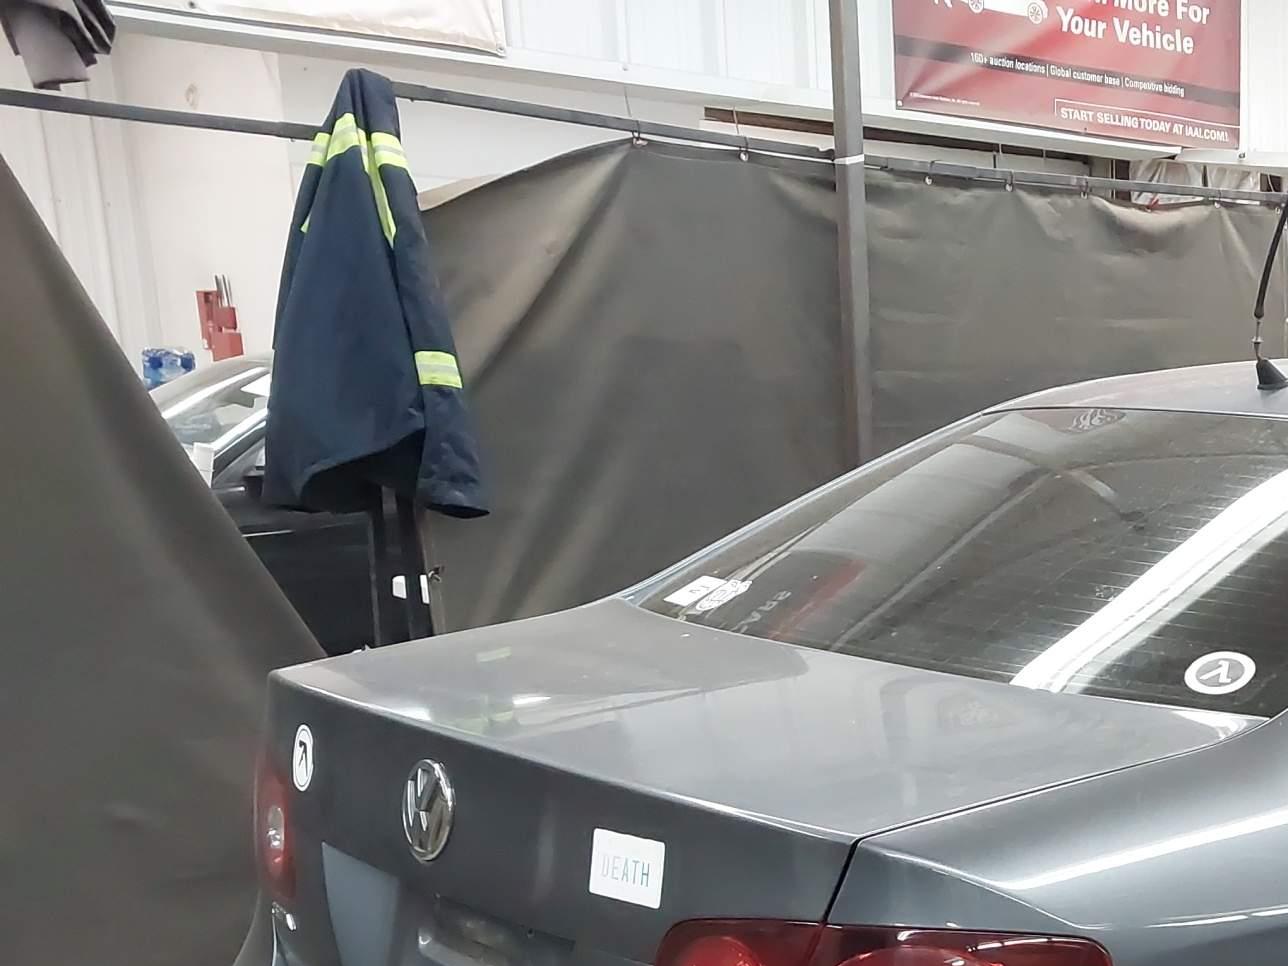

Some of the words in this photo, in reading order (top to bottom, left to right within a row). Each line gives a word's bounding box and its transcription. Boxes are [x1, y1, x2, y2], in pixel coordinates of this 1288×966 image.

[1176, 0, 1210, 24] For
[1056, 6, 1107, 39] Your
[1112, 16, 1195, 54] Vehicle
[990, 56, 1014, 69] auction
[1015, 59, 1045, 74] locations
[1050, 65, 1072, 78] Global
[1072, 70, 1103, 83] customer
[1104, 74, 1120, 86] base
[1125, 77, 1163, 92] Competitive
[1163, 82, 1185, 97] bidding
[1060, 107, 1094, 121] START
[1097, 112, 1139, 129] SELLING
[1139, 118, 1171, 133] TODAY
[1172, 123, 1184, 135] AT
[601, 854, 651, 887] DEATH
